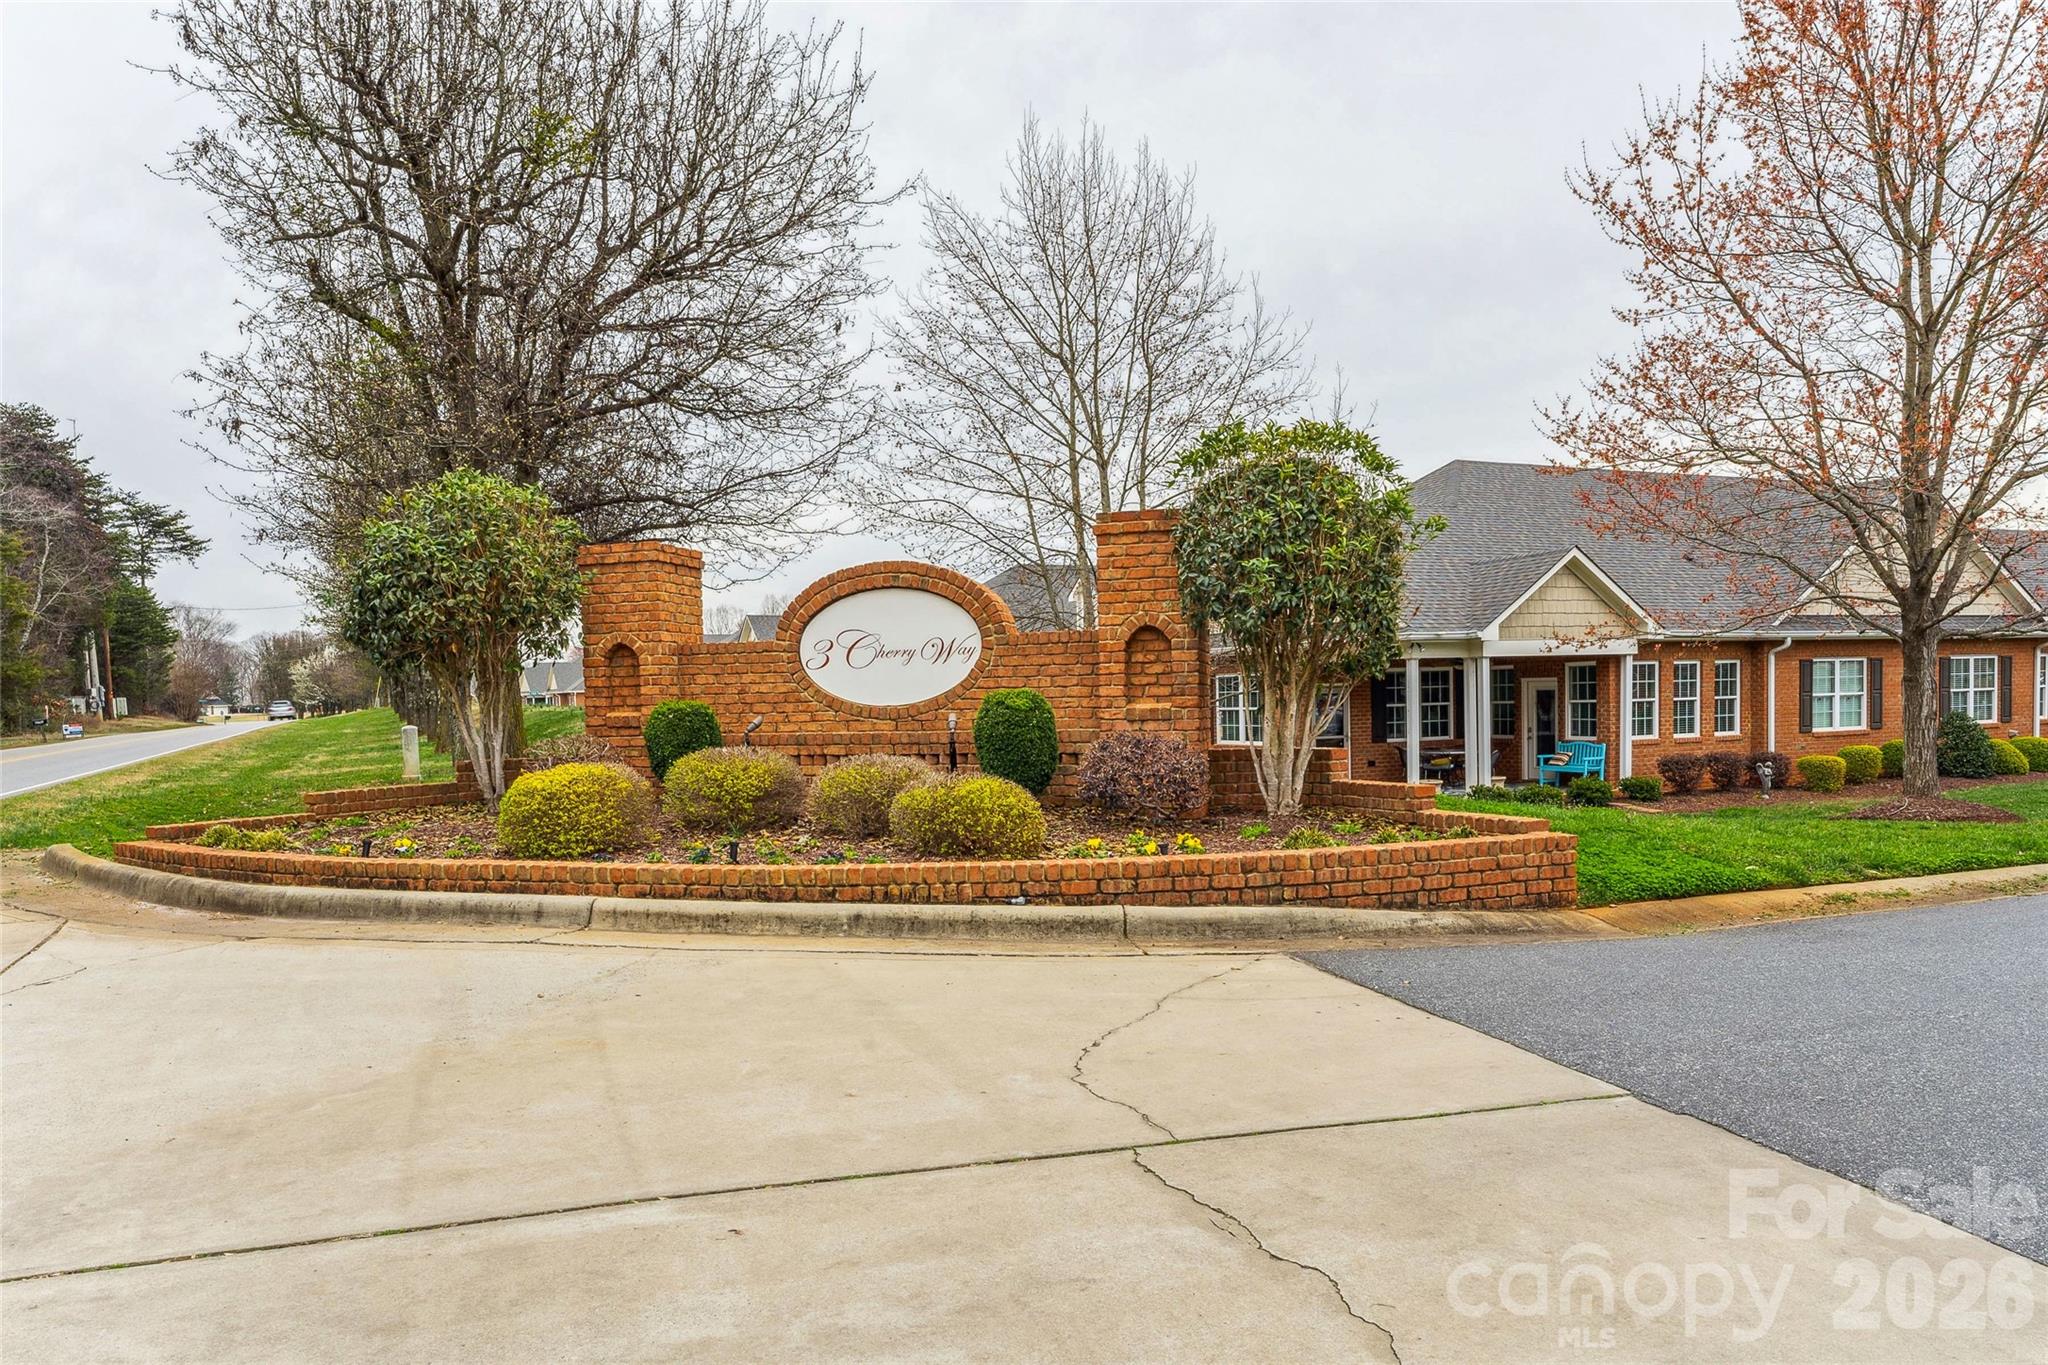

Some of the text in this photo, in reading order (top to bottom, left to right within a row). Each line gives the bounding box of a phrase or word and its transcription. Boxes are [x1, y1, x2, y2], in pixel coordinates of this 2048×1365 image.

[805, 628, 977, 671] 3 Cherry Way
